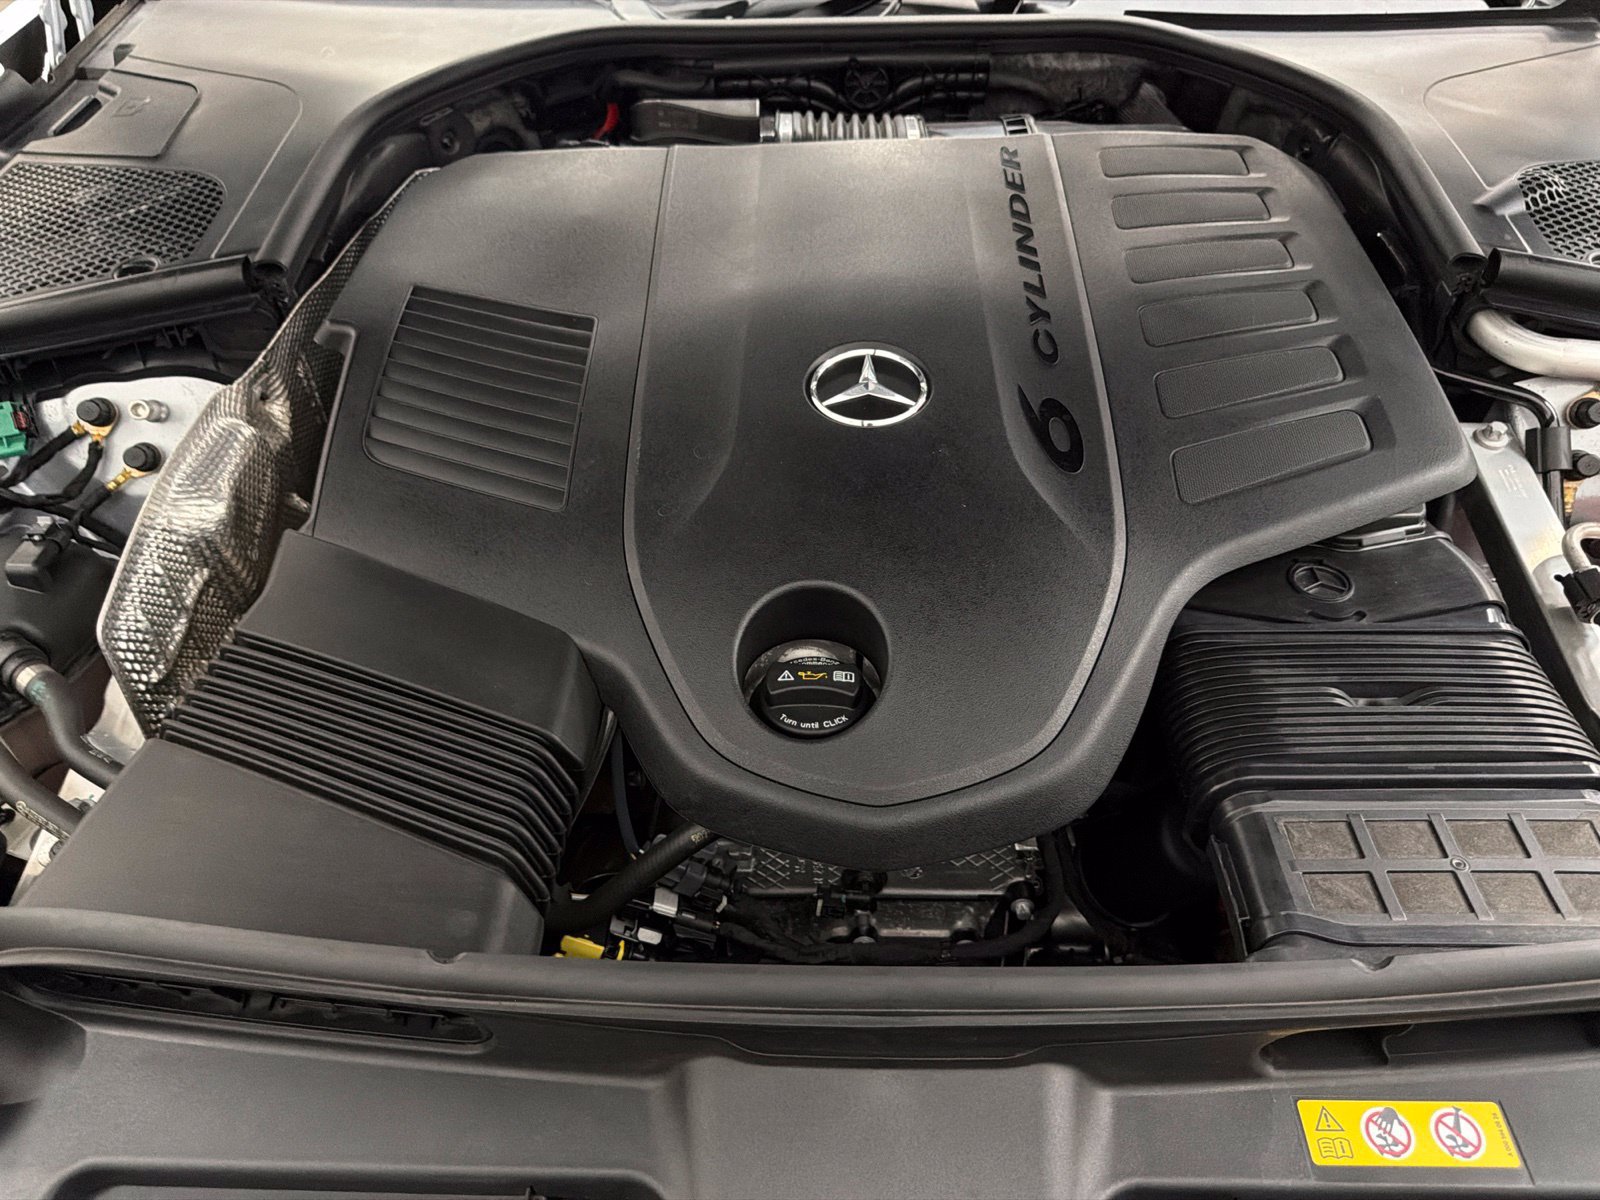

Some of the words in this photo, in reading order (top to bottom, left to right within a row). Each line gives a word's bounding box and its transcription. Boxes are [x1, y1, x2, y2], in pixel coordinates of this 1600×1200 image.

[1001, 145, 1060, 366] CYLINDER
[1017, 383, 1085, 475] 6
[779, 713, 797, 726] Turn
[800, 721, 819, 729] until
[822, 714, 849, 728] CLICK
